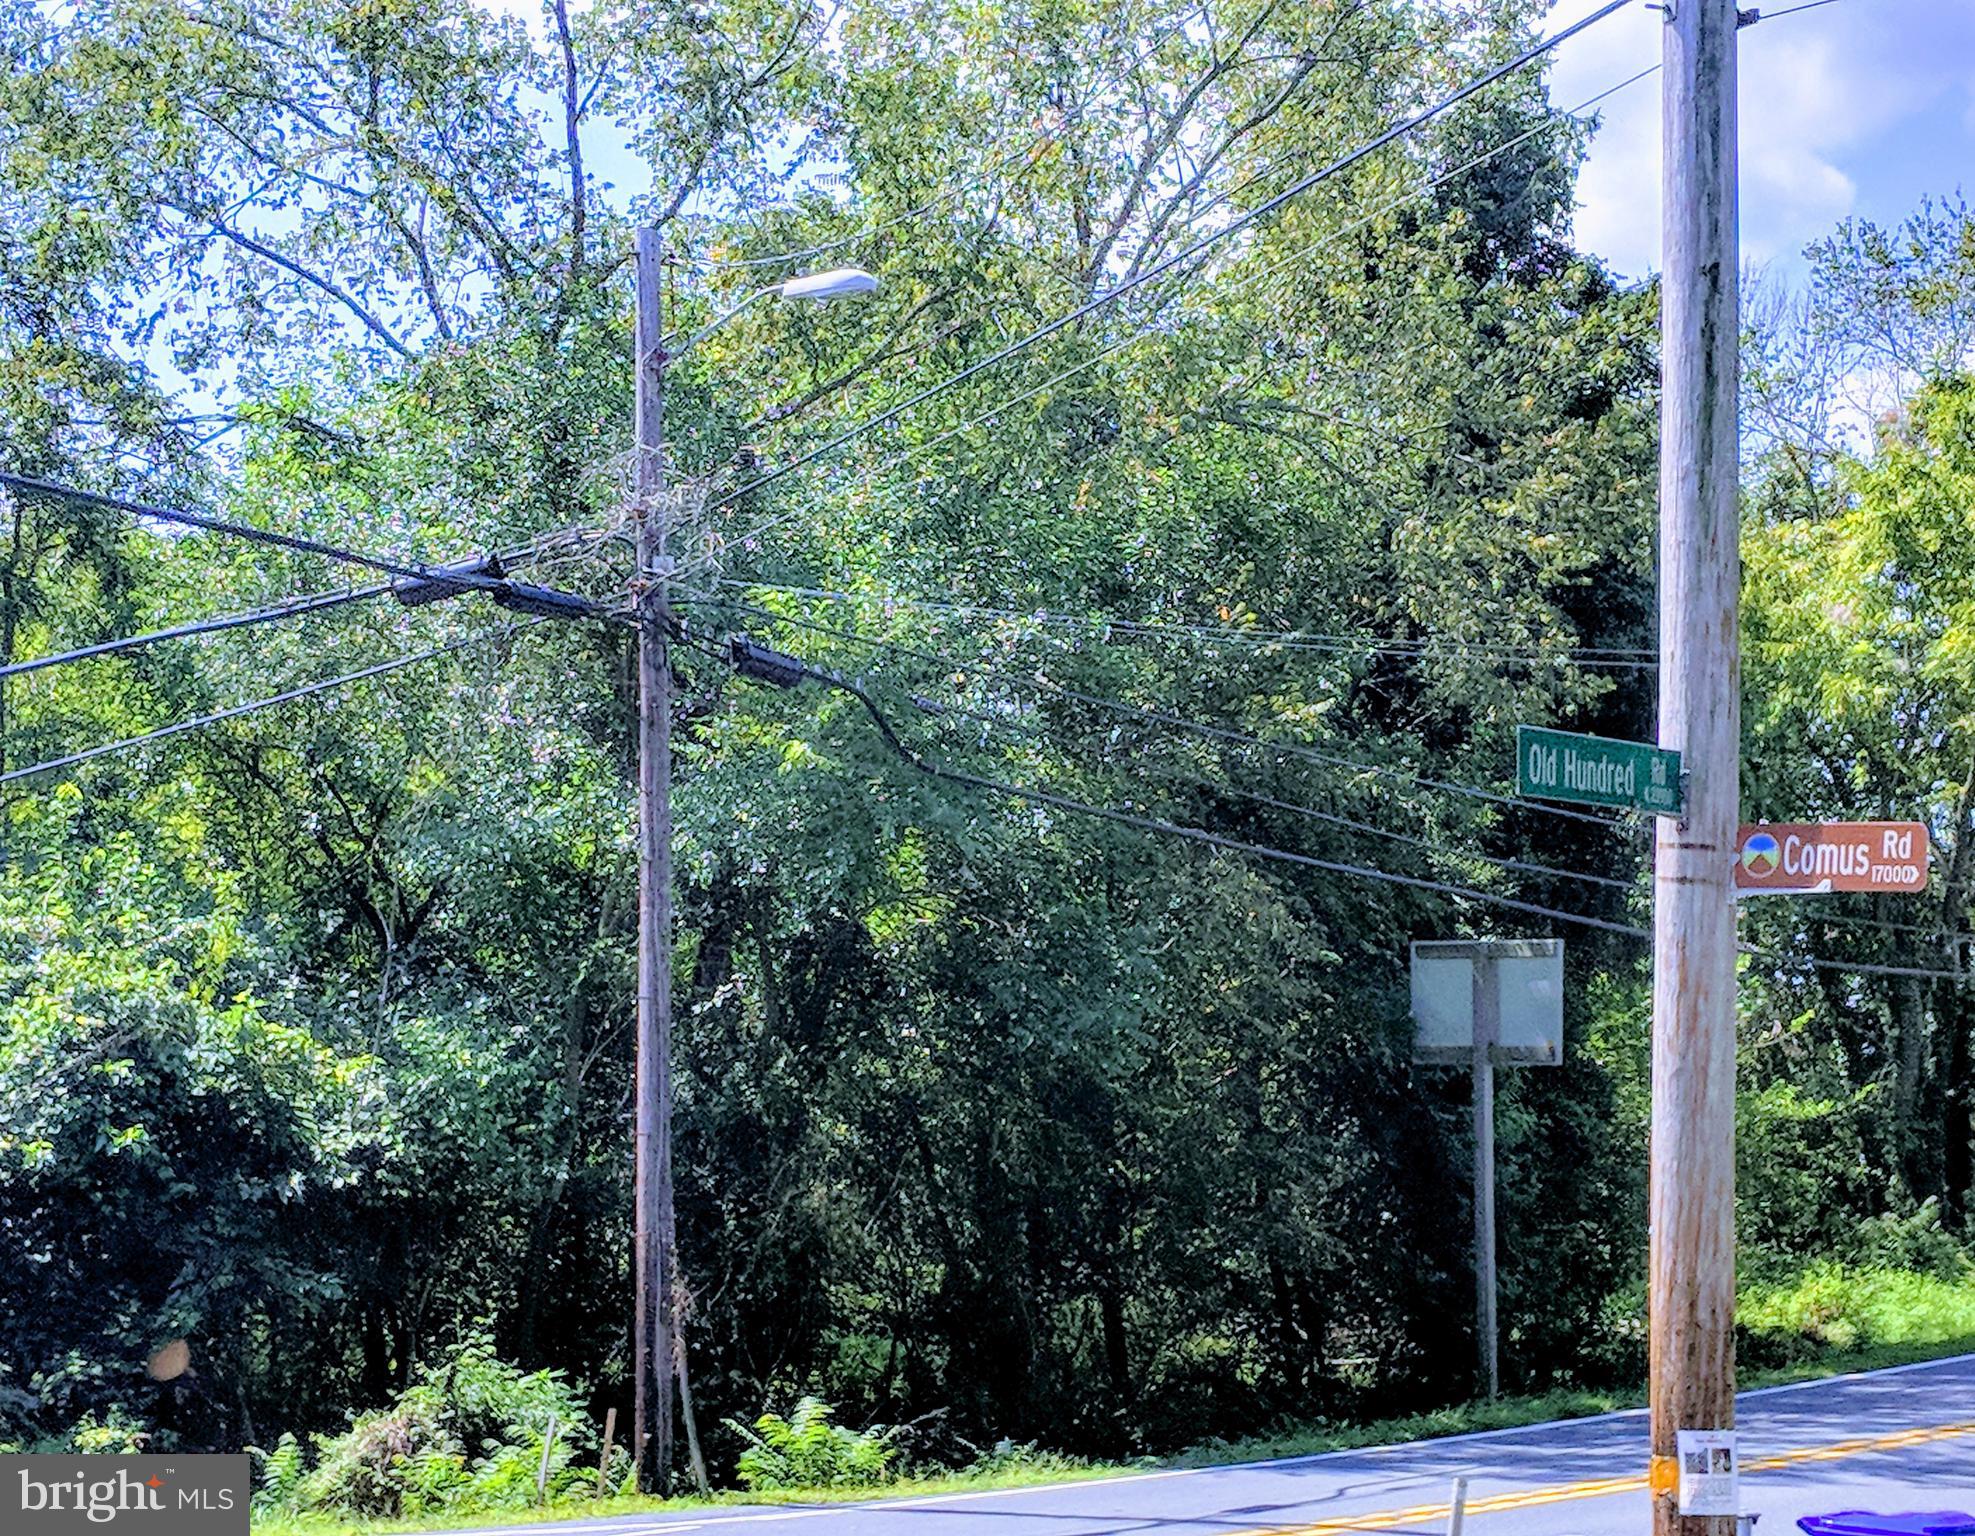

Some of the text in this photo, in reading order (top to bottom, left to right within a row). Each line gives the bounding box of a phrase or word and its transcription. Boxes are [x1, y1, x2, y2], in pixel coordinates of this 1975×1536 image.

[1529, 743, 1557, 786] Old
[1564, 749, 1635, 797] Hundred
[1783, 829, 1912, 876] Comus Rd
[1871, 864, 1911, 884] 17000
